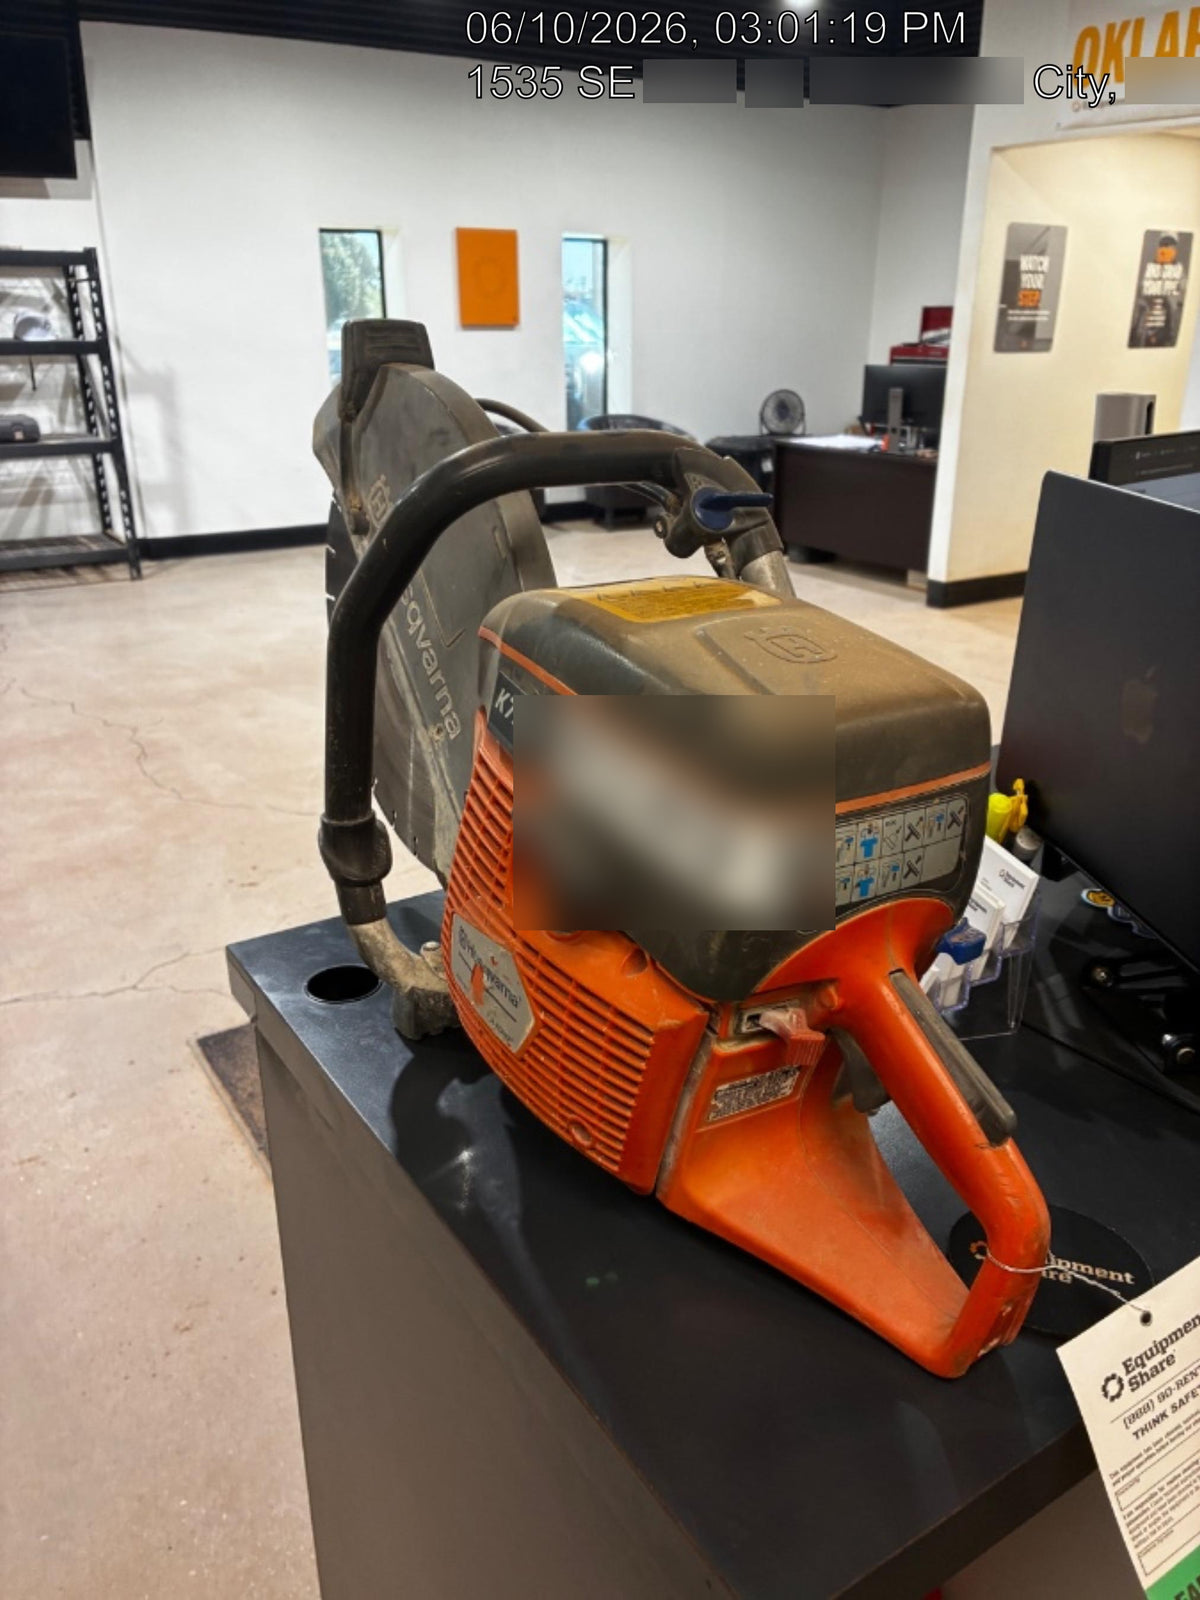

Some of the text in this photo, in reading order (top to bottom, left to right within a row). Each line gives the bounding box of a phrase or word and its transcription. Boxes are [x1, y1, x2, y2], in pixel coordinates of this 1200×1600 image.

[401, 585, 461, 740] sqvarna
[1122, 1314, 1200, 1376] Equipmen
[1128, 1353, 1176, 1392] Share
[1132, 1385, 1200, 1441] THINK SAFE
